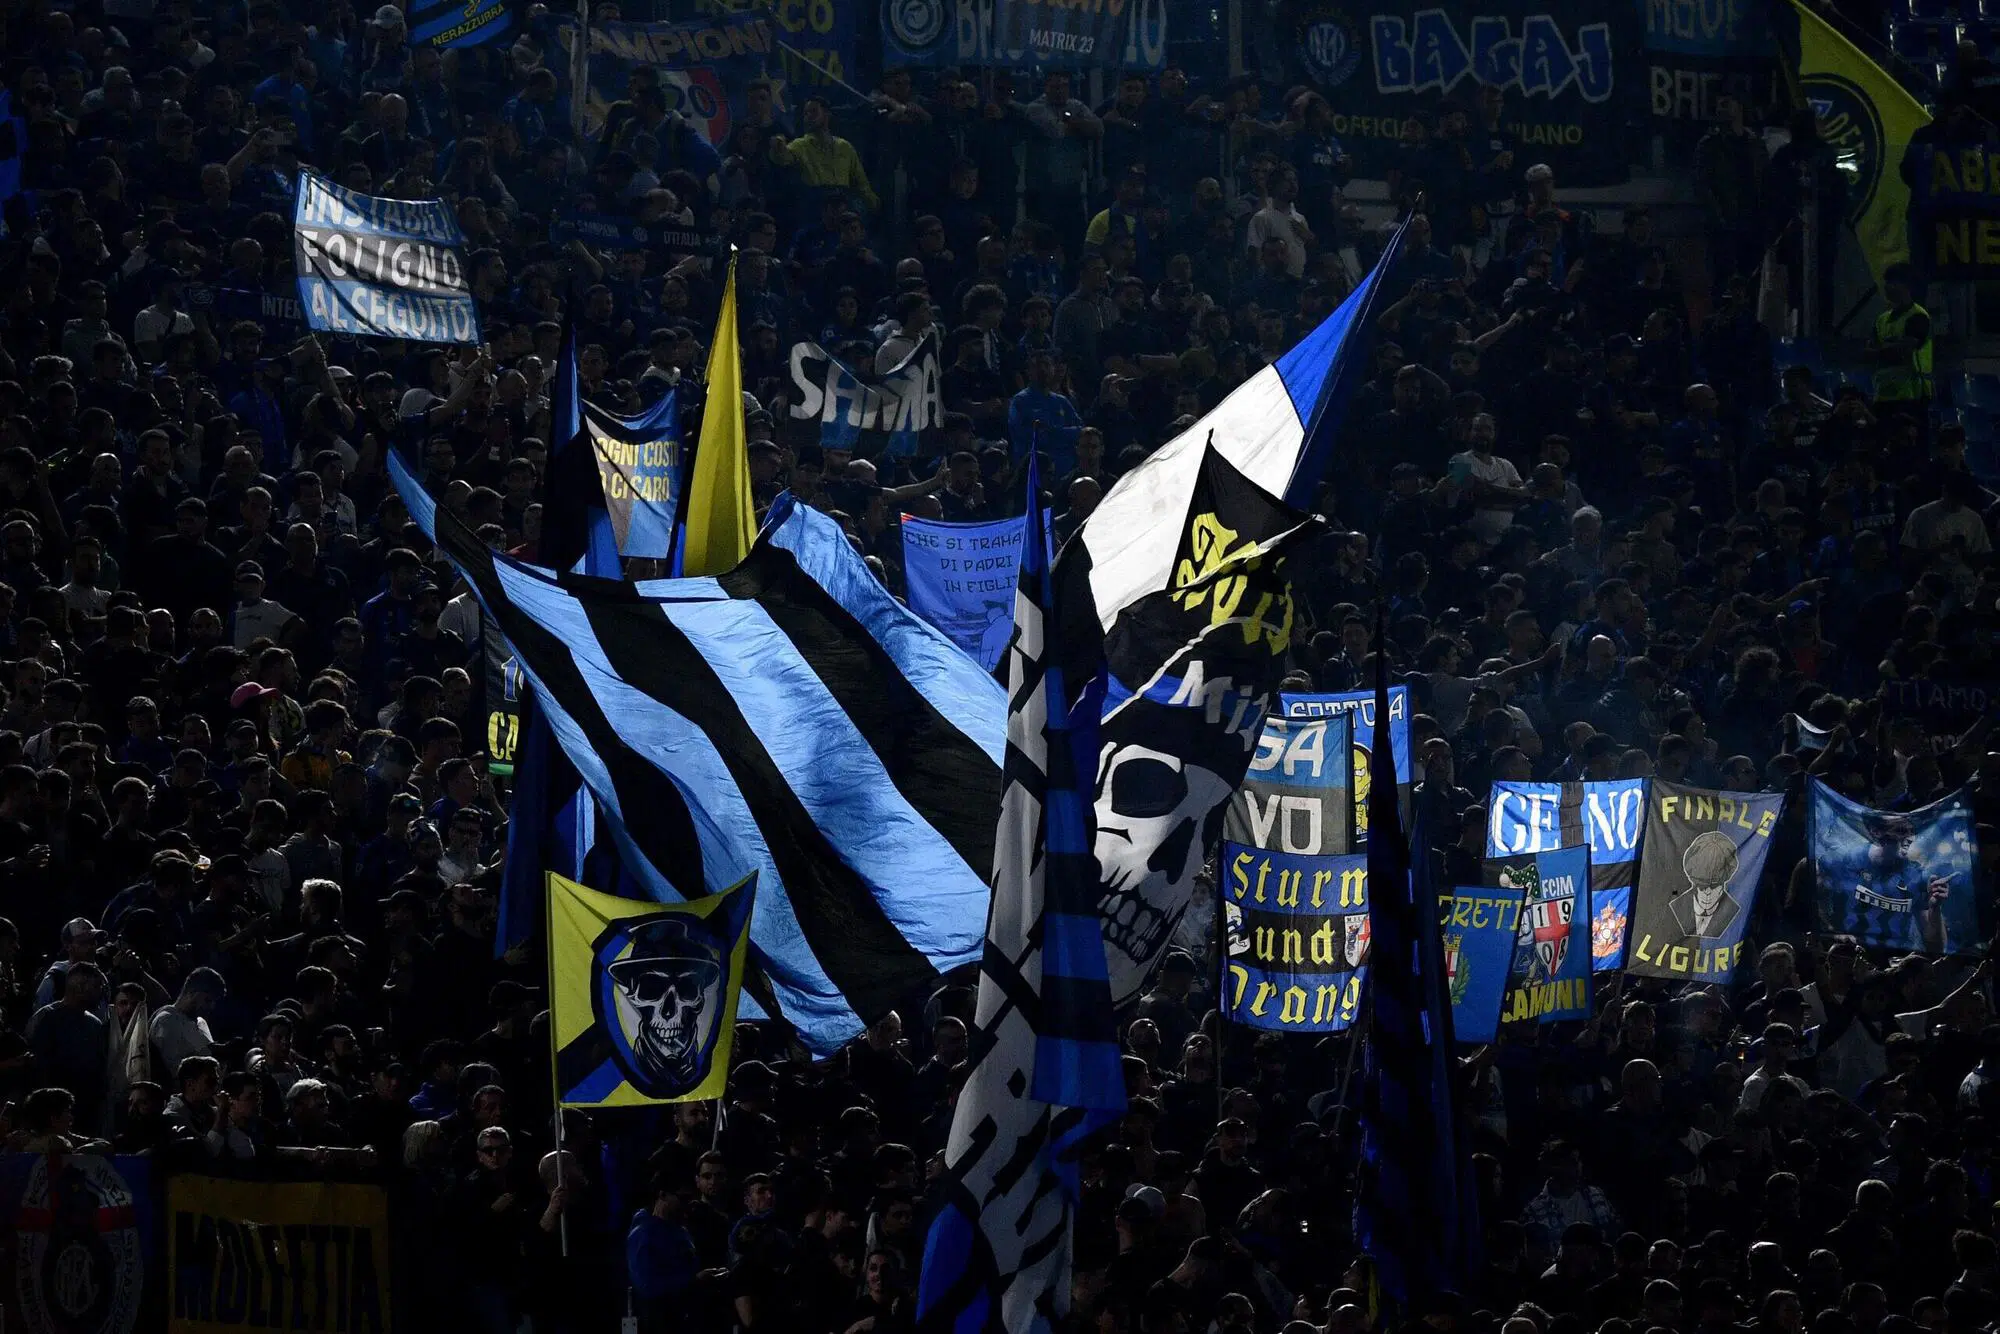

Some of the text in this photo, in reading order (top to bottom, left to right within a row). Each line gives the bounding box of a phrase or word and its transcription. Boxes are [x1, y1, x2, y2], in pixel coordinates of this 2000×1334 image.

[1028, 28, 1095, 54] MATRIX 23
[301, 230, 463, 292] FOLIGNO
[311, 283, 471, 342] AL SEGUITO
[596, 437, 640, 466] OGNI
[611, 472, 629, 499] CI
[631, 471, 671, 501] SARÒ
[903, 531, 939, 548] CHE
[946, 538, 964, 550] SI
[940, 555, 1014, 573] DI PADRI
[943, 574, 1018, 593] IN FIGLI
[1928, 683, 1987, 713] AMO
[1249, 716, 1328, 778] SA
[1243, 790, 1322, 855] VO
[1661, 793, 1778, 838] FINALE
[1232, 851, 1368, 909] Sturm
[1541, 875, 1575, 899] FCIM
[1255, 918, 1336, 965] und
[1635, 933, 1745, 976] LIGURE
